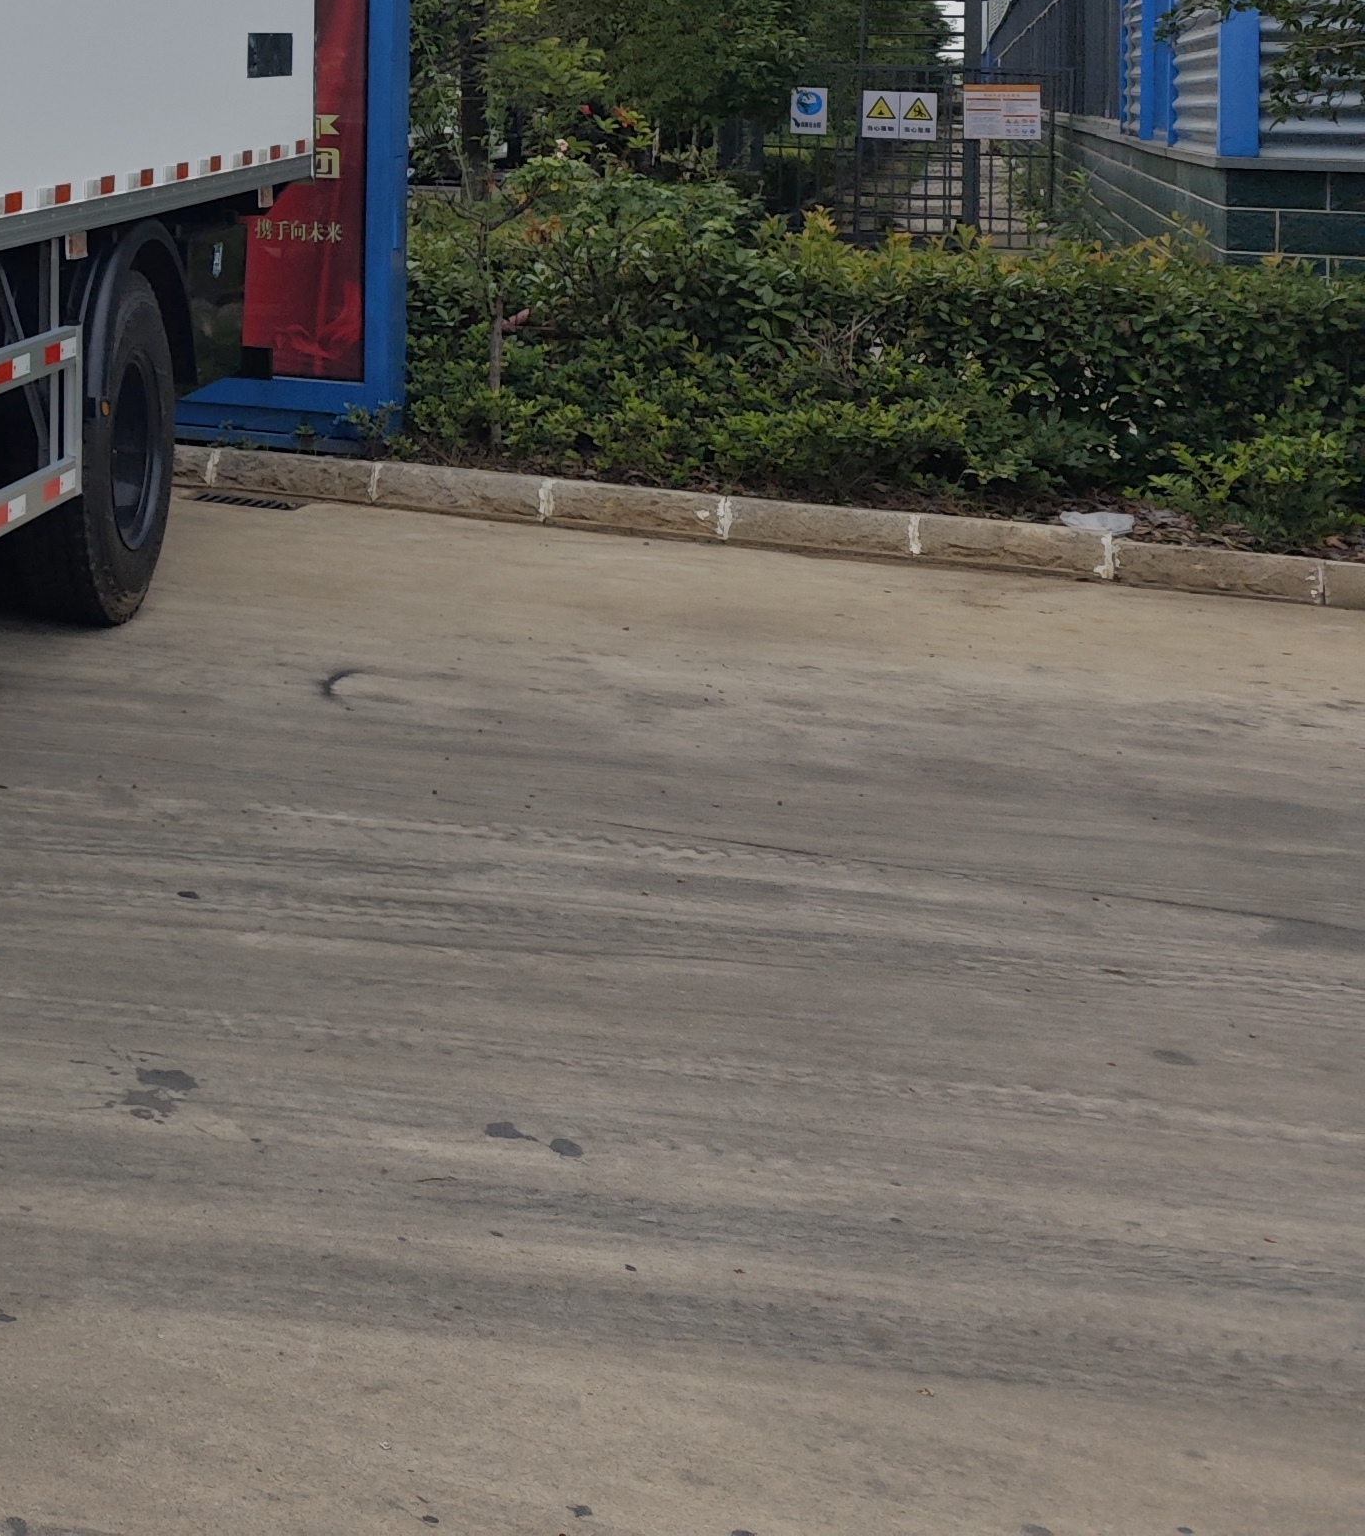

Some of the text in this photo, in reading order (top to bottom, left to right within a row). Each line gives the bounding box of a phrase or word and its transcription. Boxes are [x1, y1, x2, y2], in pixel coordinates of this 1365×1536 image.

[254, 217, 343, 244] 携手向未来
